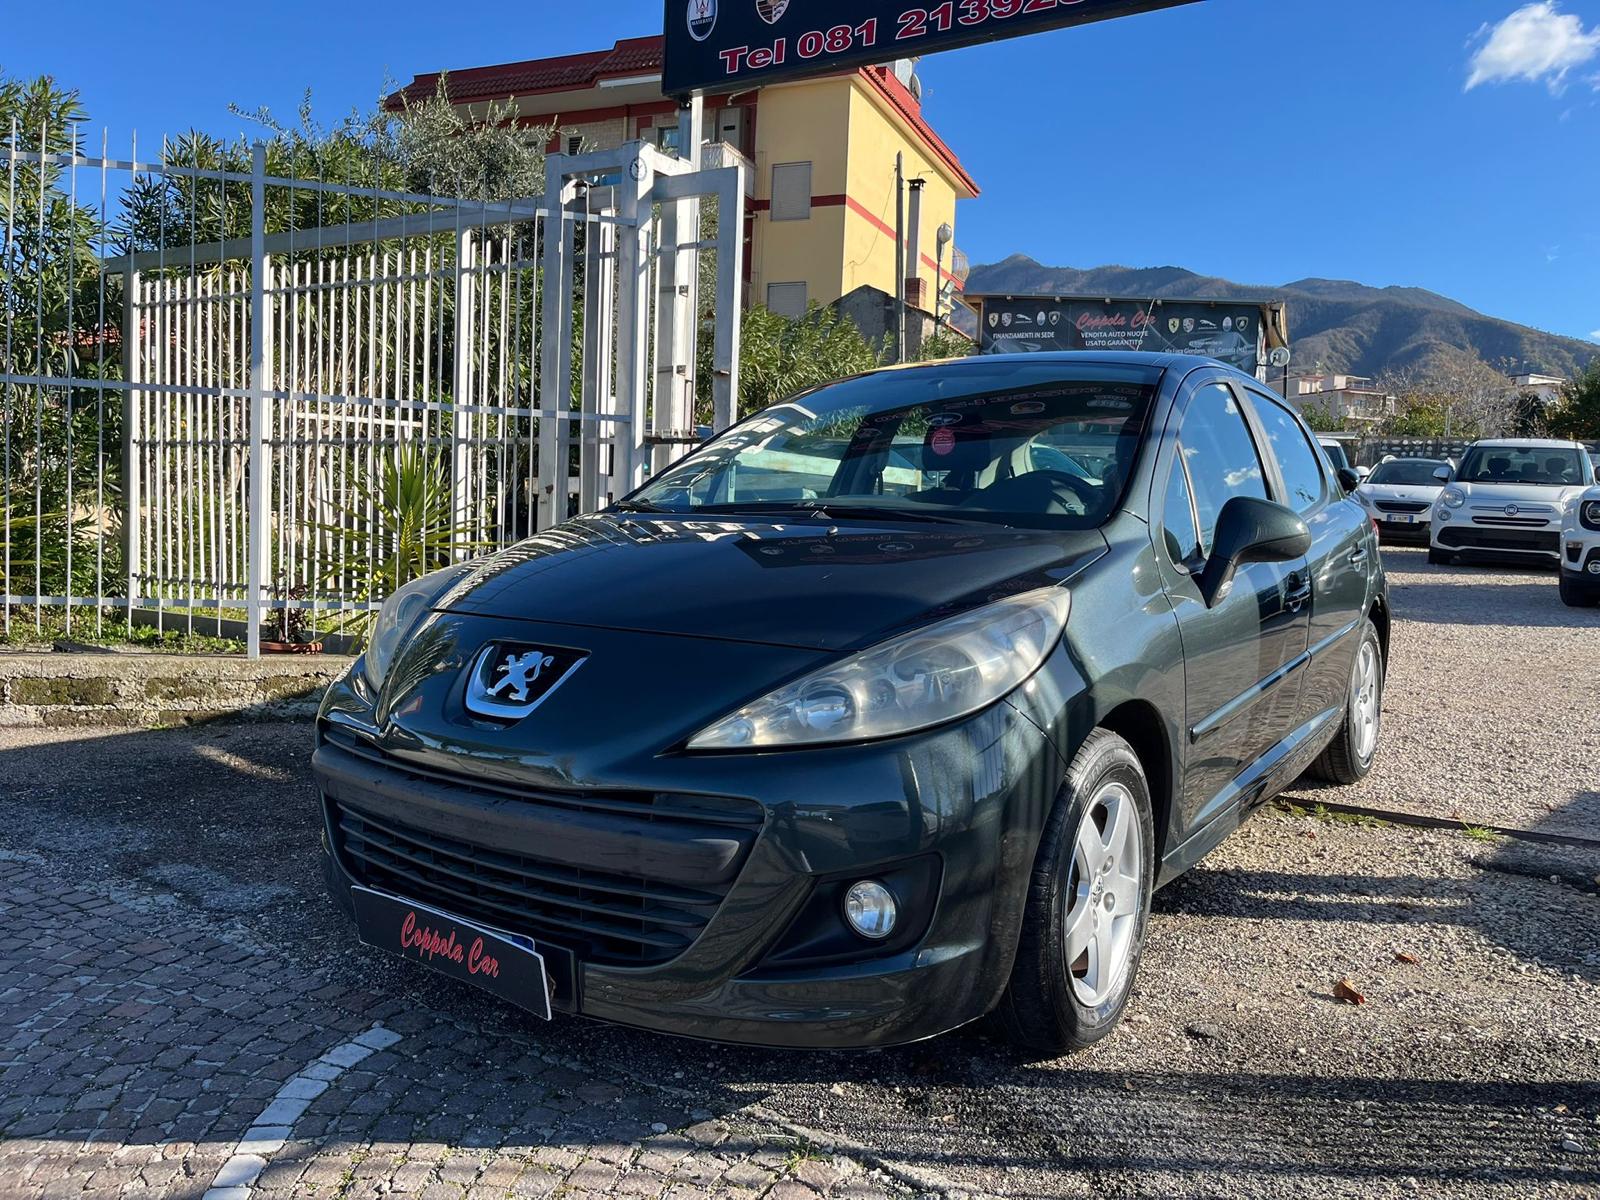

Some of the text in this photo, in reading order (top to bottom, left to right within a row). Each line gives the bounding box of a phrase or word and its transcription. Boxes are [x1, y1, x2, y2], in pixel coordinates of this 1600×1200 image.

[719, 45, 786, 74] Tel
[797, 18, 877, 59] 081
[992, 332, 1033, 340] FINANZIAMENTI
[1041, 331, 1055, 339] SEDE
[1075, 312, 1127, 330] Coppola
[401, 911, 500, 978] Coppola Car
